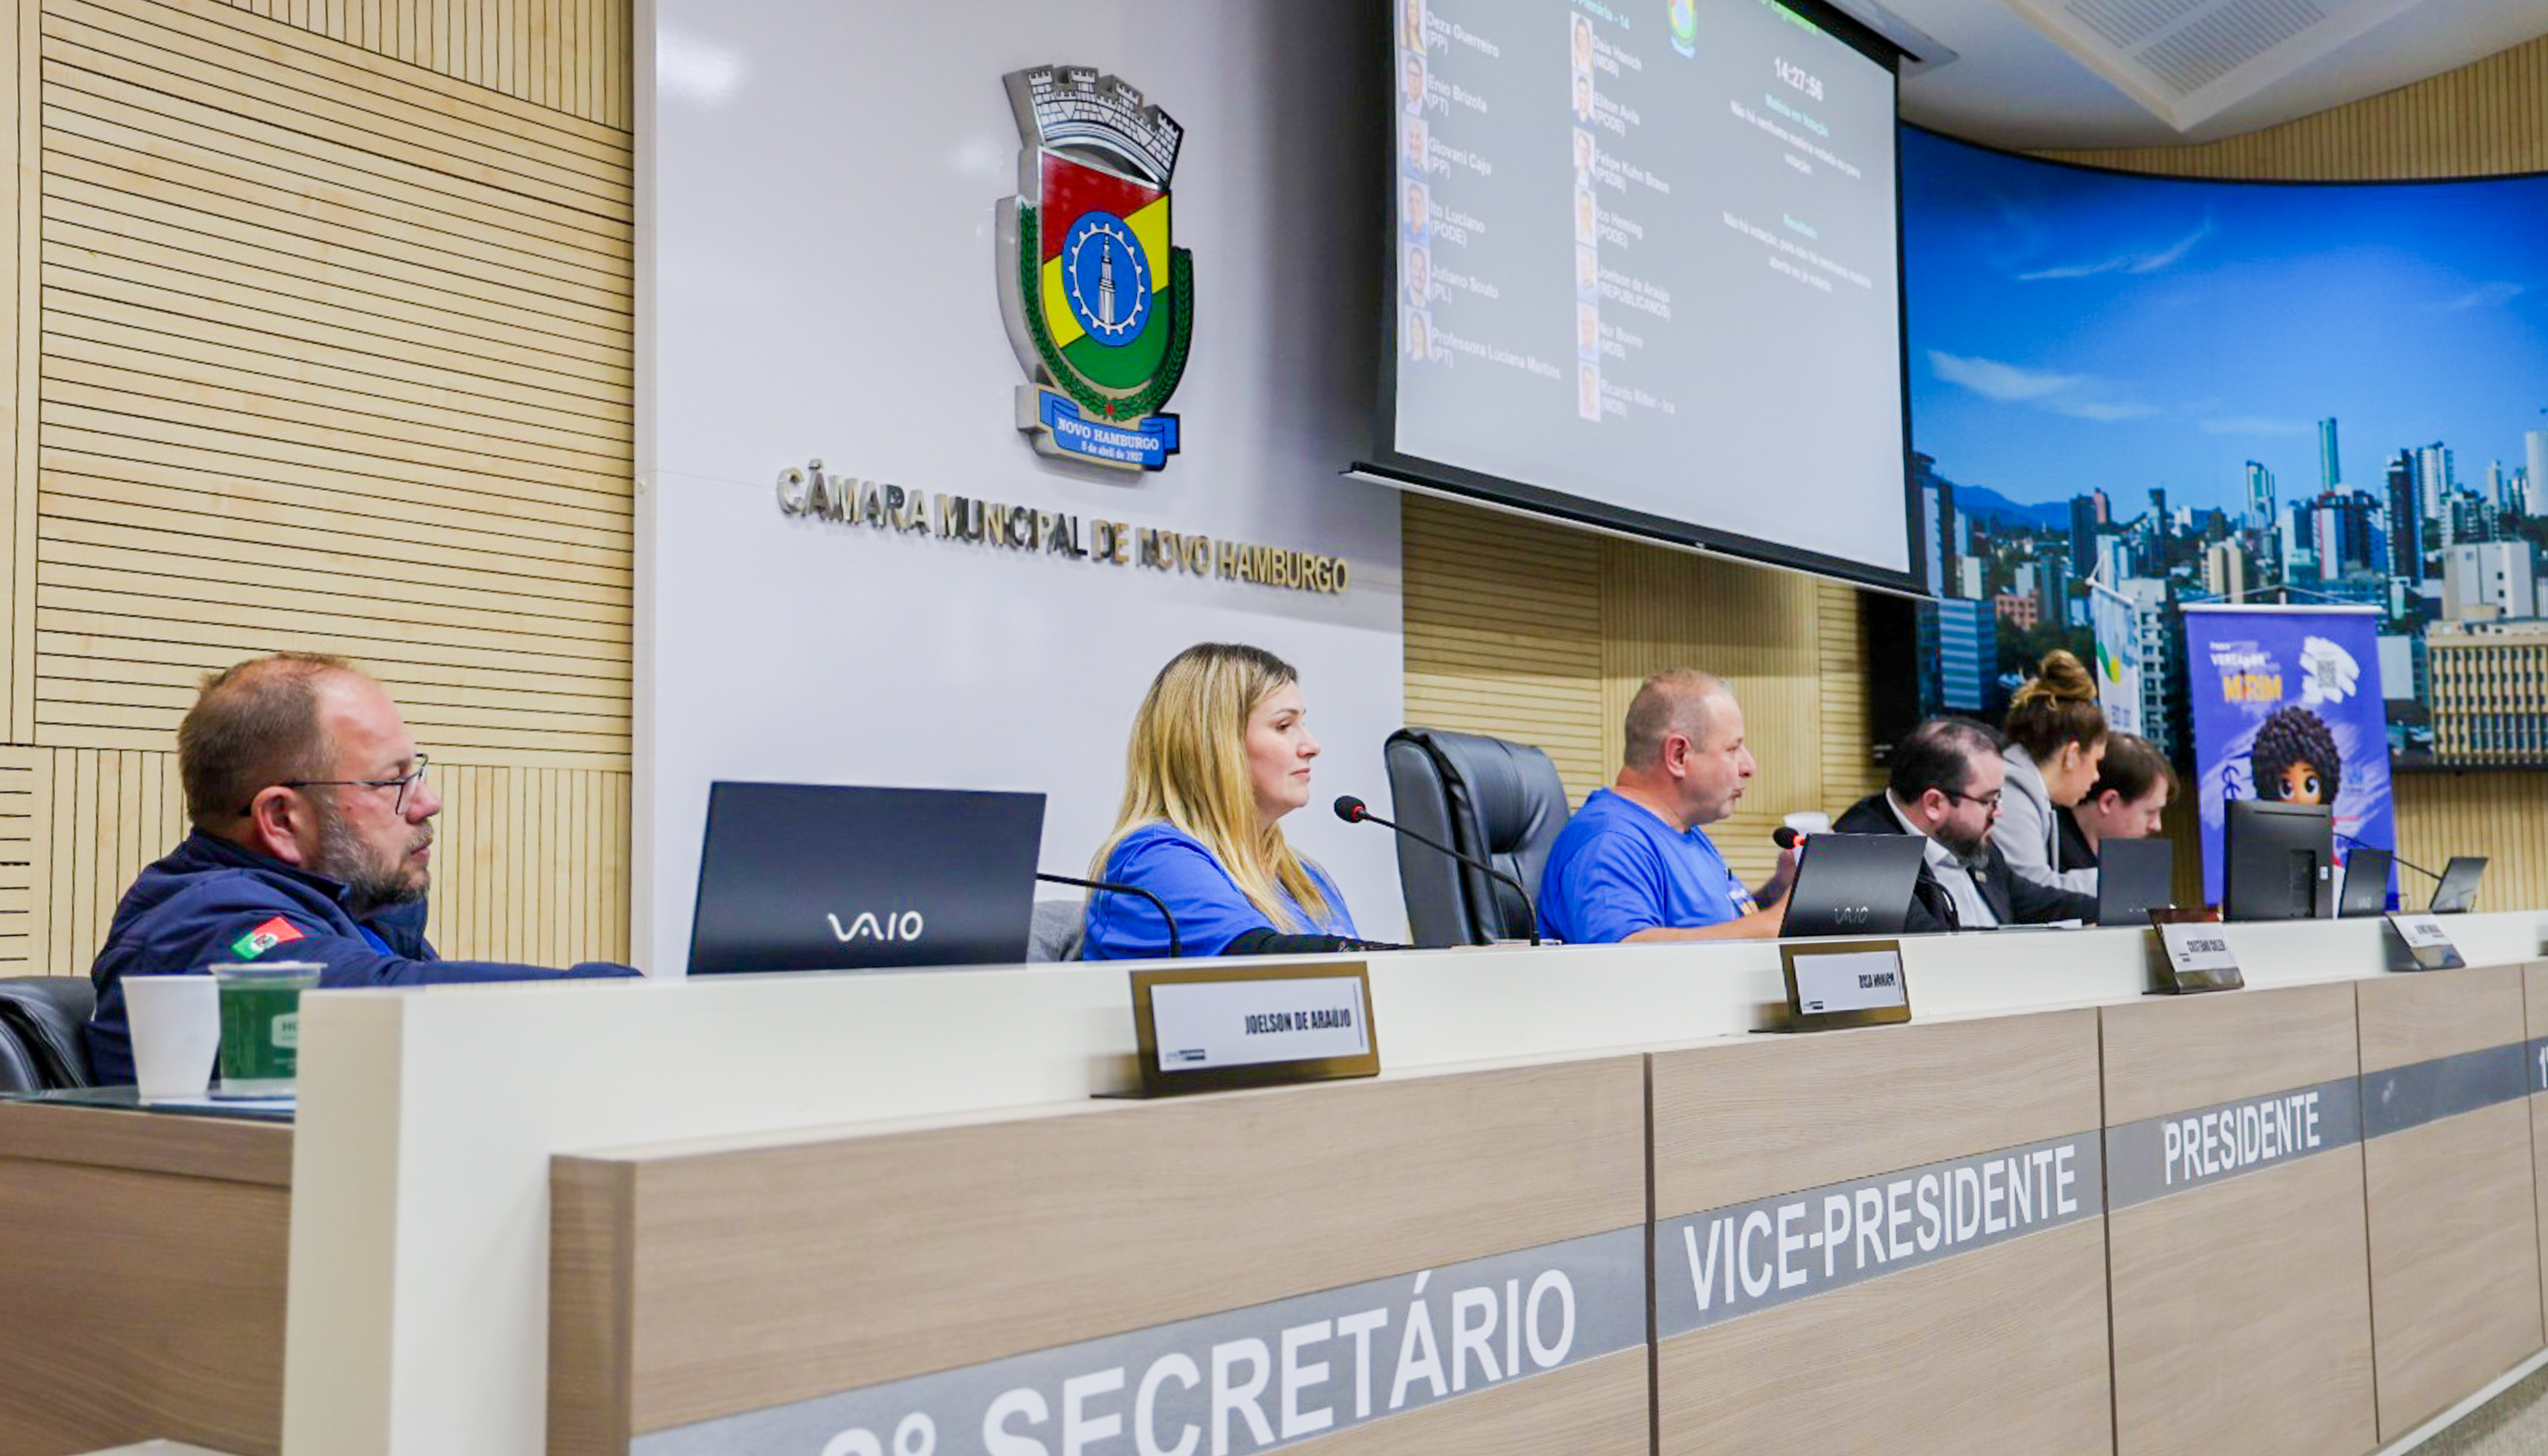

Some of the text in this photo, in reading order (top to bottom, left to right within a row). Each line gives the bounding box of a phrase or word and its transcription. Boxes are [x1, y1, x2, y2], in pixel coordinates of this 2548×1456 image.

[1429, 136, 1467, 165] Giovani
[1445, 205, 1485, 234] Luciano
[1432, 327, 1561, 380] Professora Luciana Martins
[1058, 417, 1159, 450] NOVO HAMBURGO
[1088, 443, 1097, 453] de
[1098, 446, 1115, 458] abril
[1116, 448, 1125, 460] de
[777, 458, 931, 534] CÂMARA
[1090, 519, 1129, 566] DE
[1136, 526, 1213, 577] NOVO
[1214, 539, 1348, 595] HAMBURGO
[827, 910, 923, 942] VAIO
[1245, 1005, 1351, 1035] JOELSON DE ARAÚJO
[2165, 1092, 2320, 1185] PRESIDENTE
[1684, 1144, 2078, 1310] VICE-PRESIDENTE
[983, 1269, 1575, 1456] SECRETÁRIO
